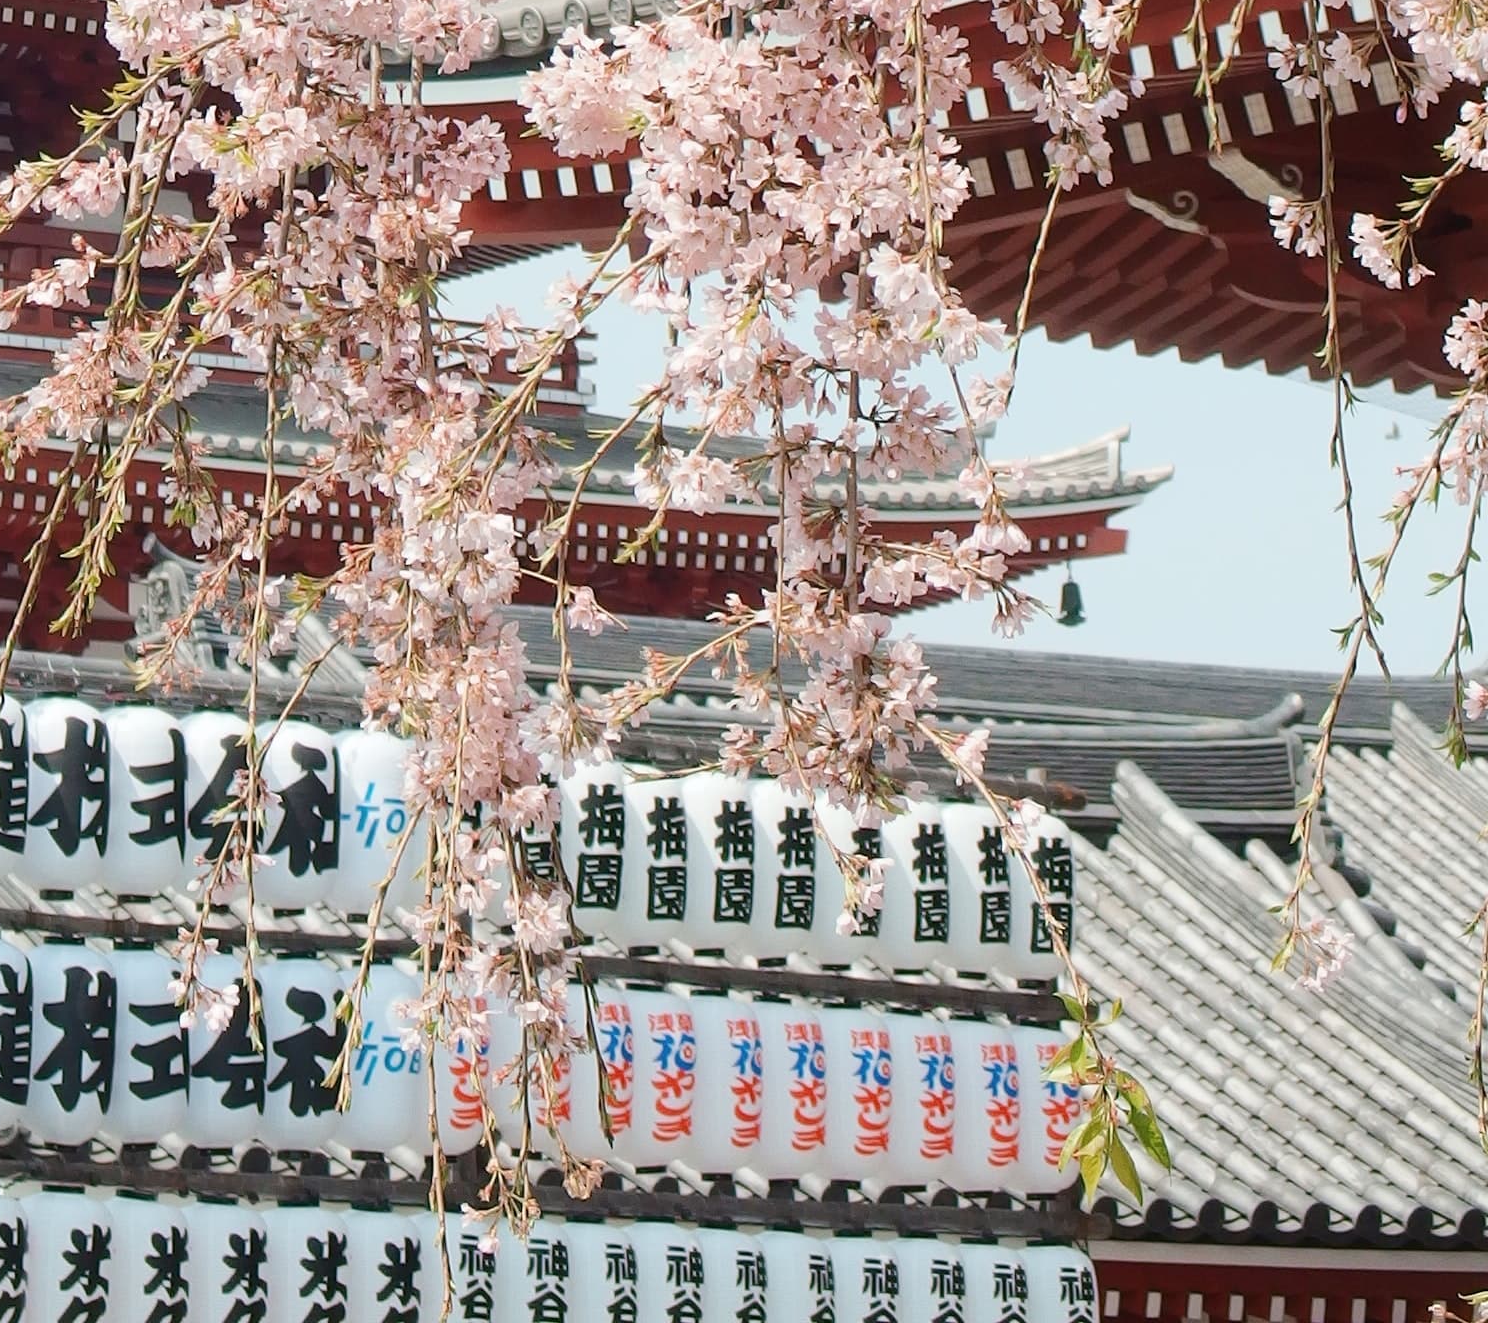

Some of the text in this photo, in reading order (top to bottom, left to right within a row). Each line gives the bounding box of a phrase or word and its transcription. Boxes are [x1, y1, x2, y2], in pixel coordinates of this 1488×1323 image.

[576, 784, 625, 911] 梅園
[646, 796, 688, 922] 梅園
[713, 801, 755, 925] 梅園
[774, 806, 816, 931] 梅園
[912, 824, 949, 943] 梅園
[527, 1238, 569, 1323] 神谷
[605, 1243, 639, 1323] 神谷
[665, 1246, 704, 1323] 神谷
